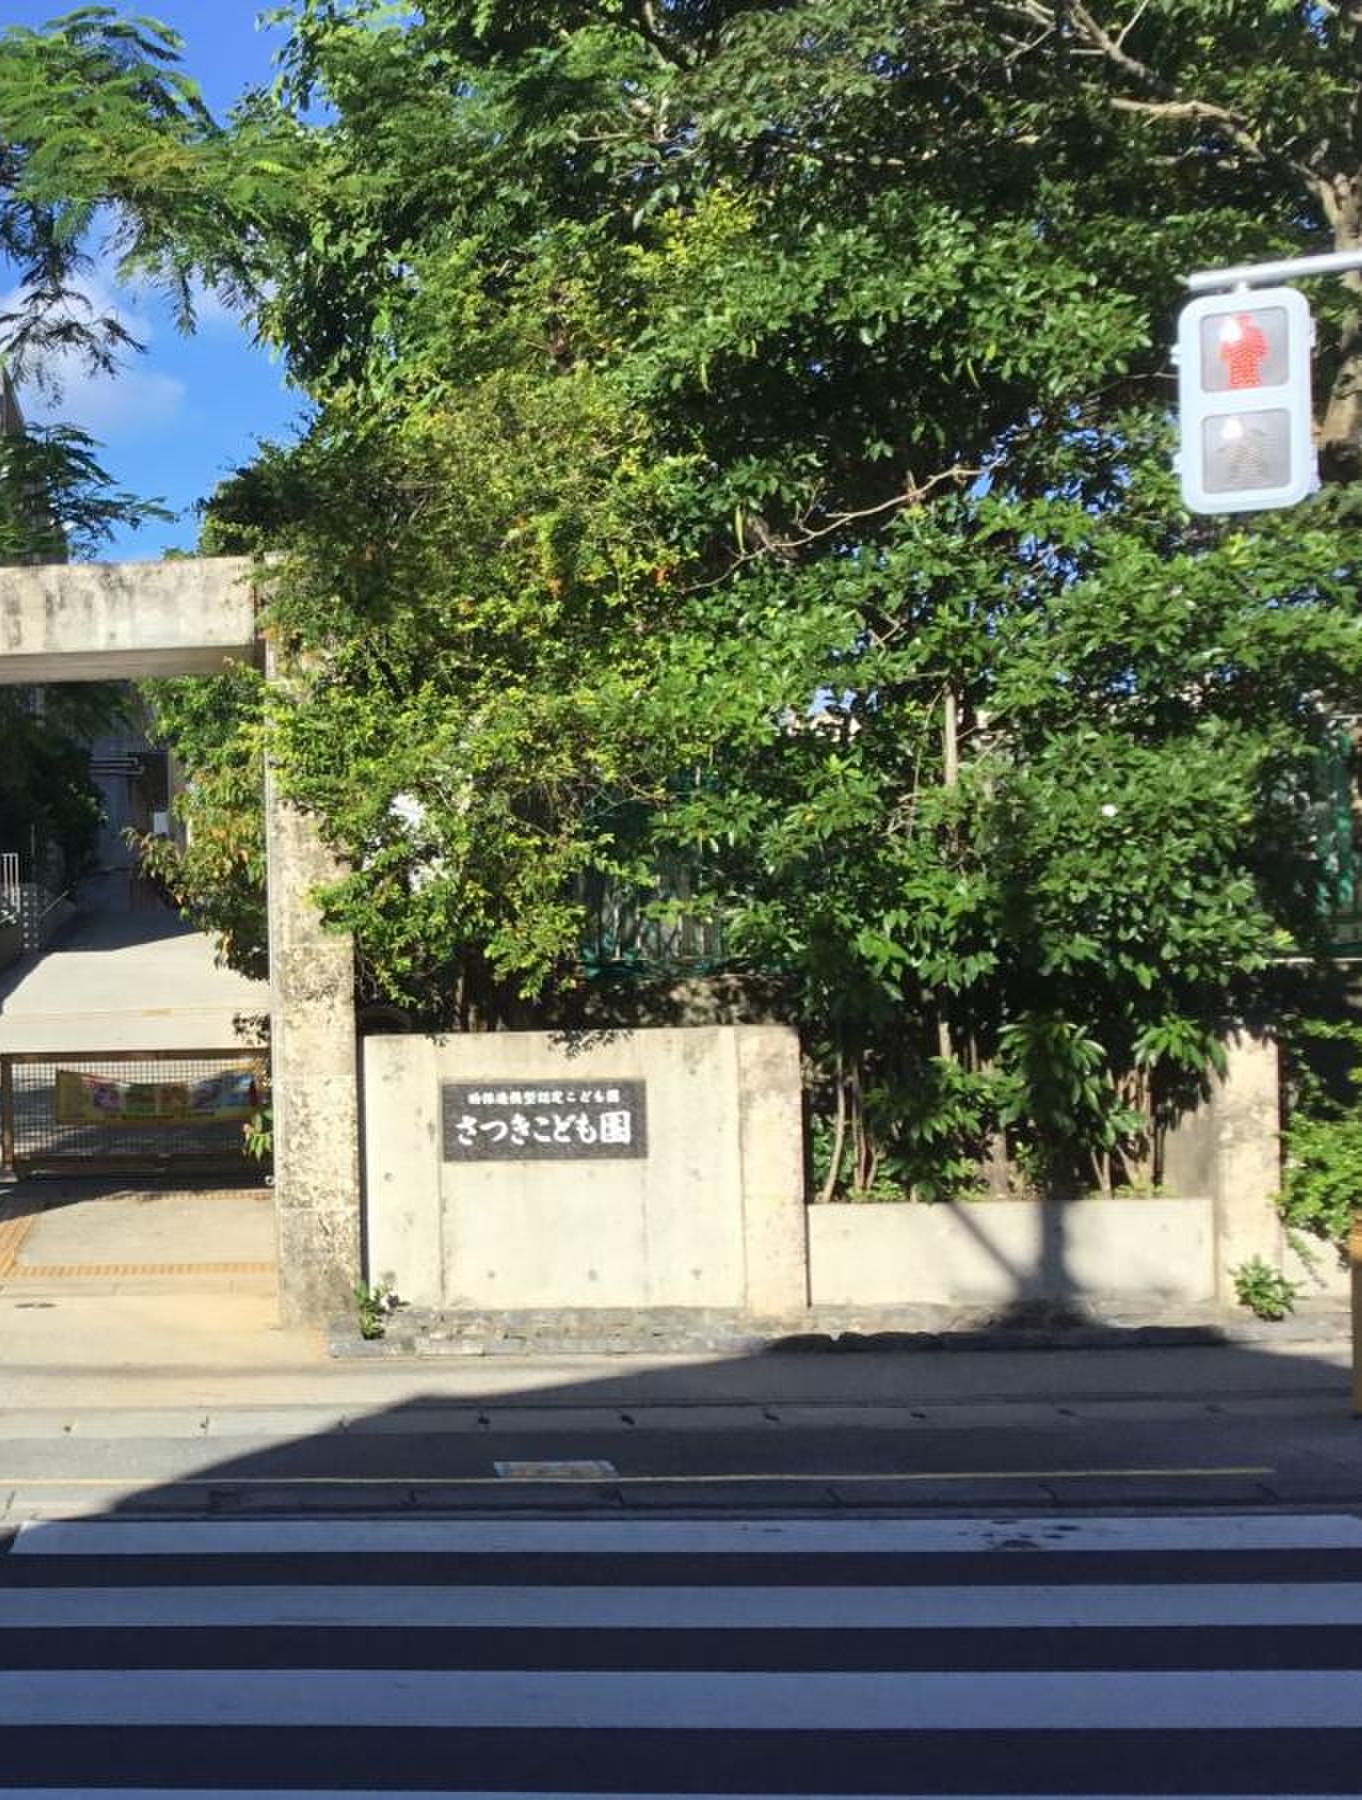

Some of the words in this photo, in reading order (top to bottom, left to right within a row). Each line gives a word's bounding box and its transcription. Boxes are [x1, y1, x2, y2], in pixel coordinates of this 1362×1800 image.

[456, 1110, 631, 1145] さつきこども園
